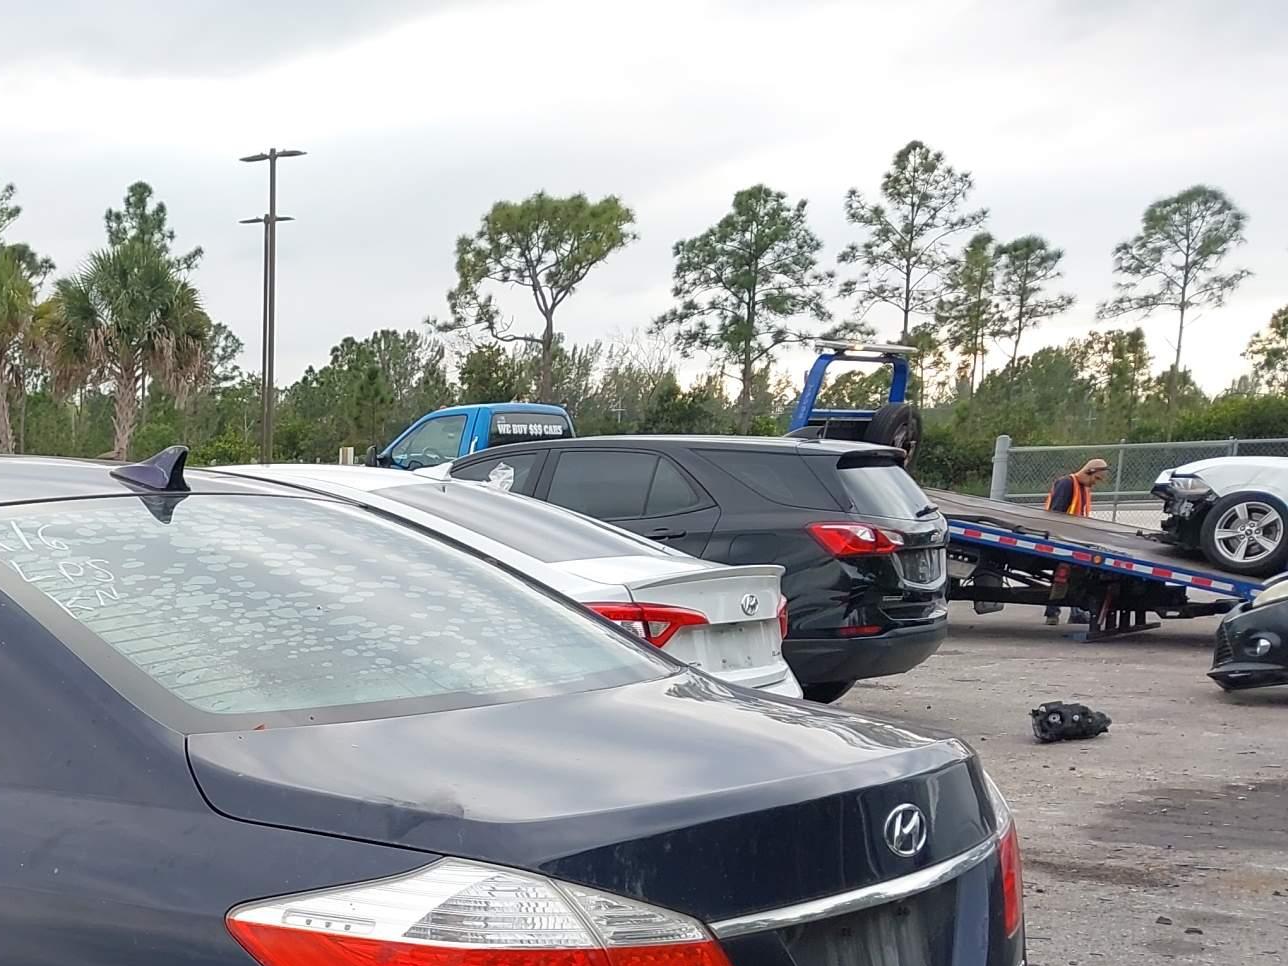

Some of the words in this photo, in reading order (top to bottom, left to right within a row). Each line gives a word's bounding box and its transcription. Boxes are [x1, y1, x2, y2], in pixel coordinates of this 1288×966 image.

[497, 423, 512, 435] WE
[512, 423, 528, 435] BUY
[543, 424, 563, 435] CARS
